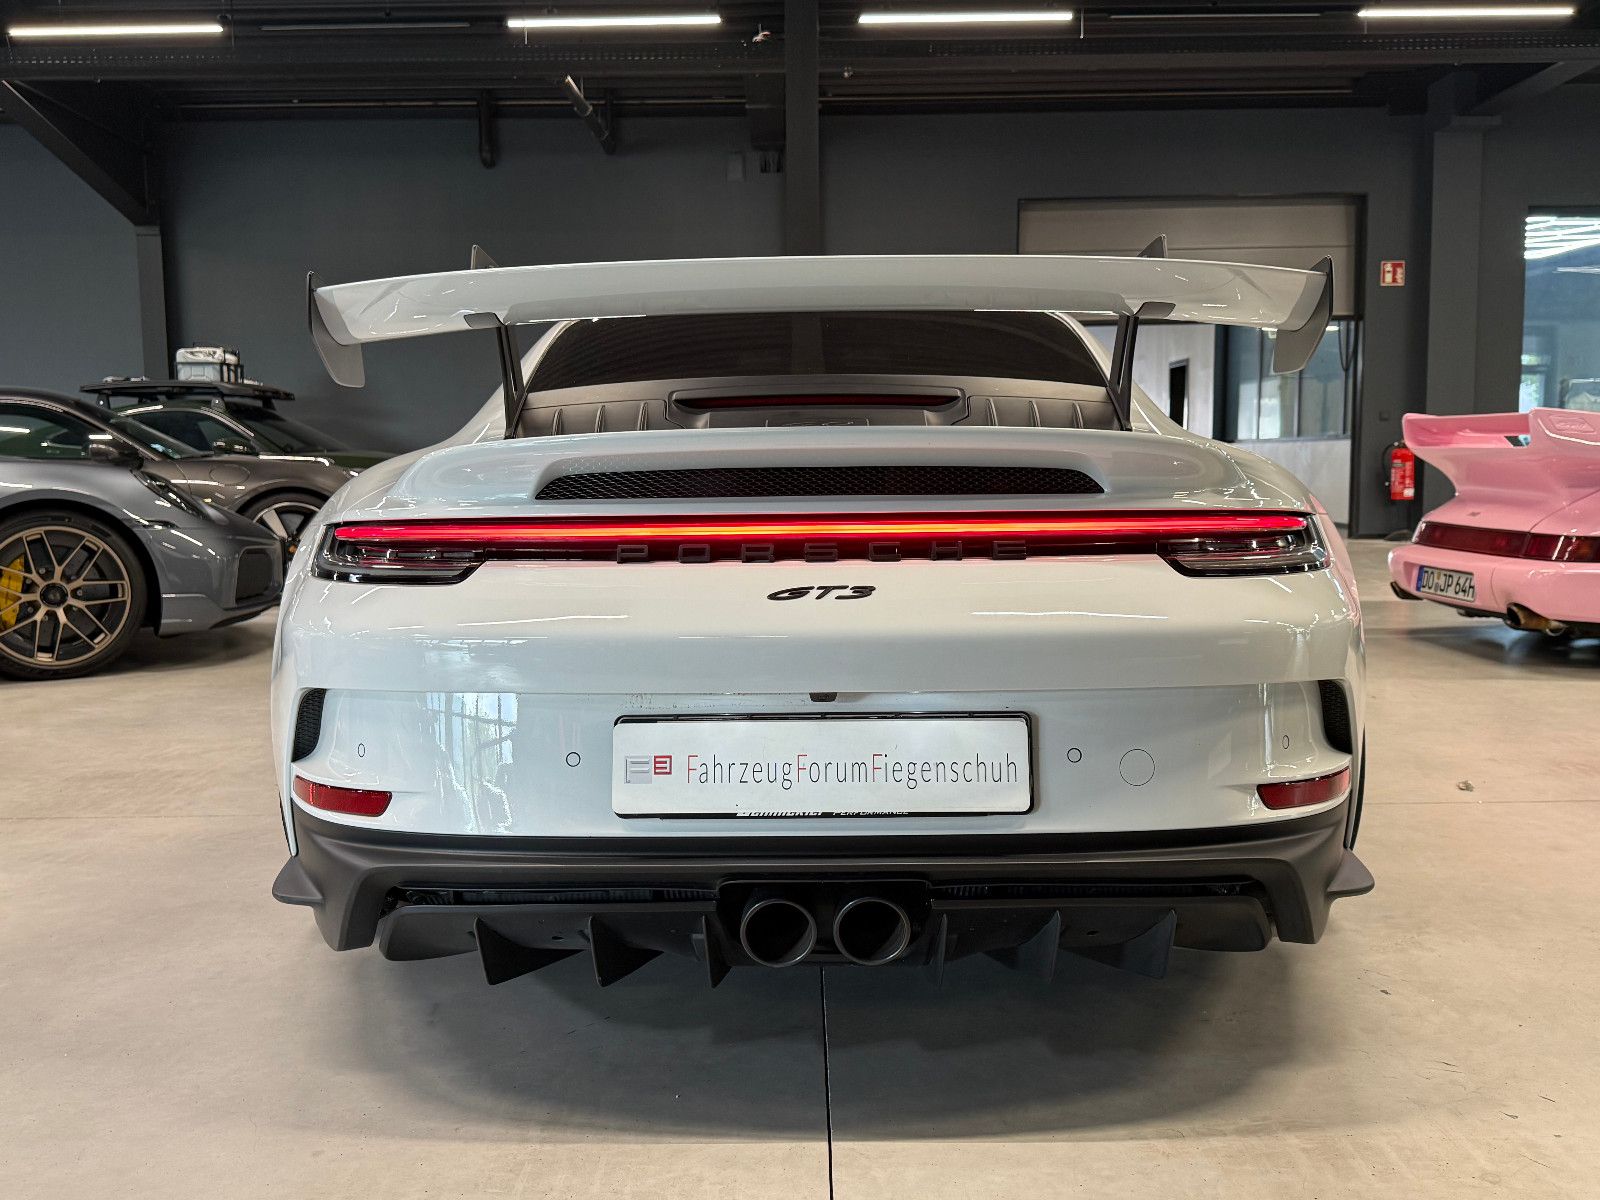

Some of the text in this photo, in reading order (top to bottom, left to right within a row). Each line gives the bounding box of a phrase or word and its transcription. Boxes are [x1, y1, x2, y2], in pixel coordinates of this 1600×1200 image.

[616, 540, 1027, 564] PORSCHE
[767, 585, 876, 600] GT3
[1421, 571, 1435, 589] DO
[1439, 573, 1454, 593] JP
[687, 753, 1018, 790] FahrzeugForumFiegenschuh
